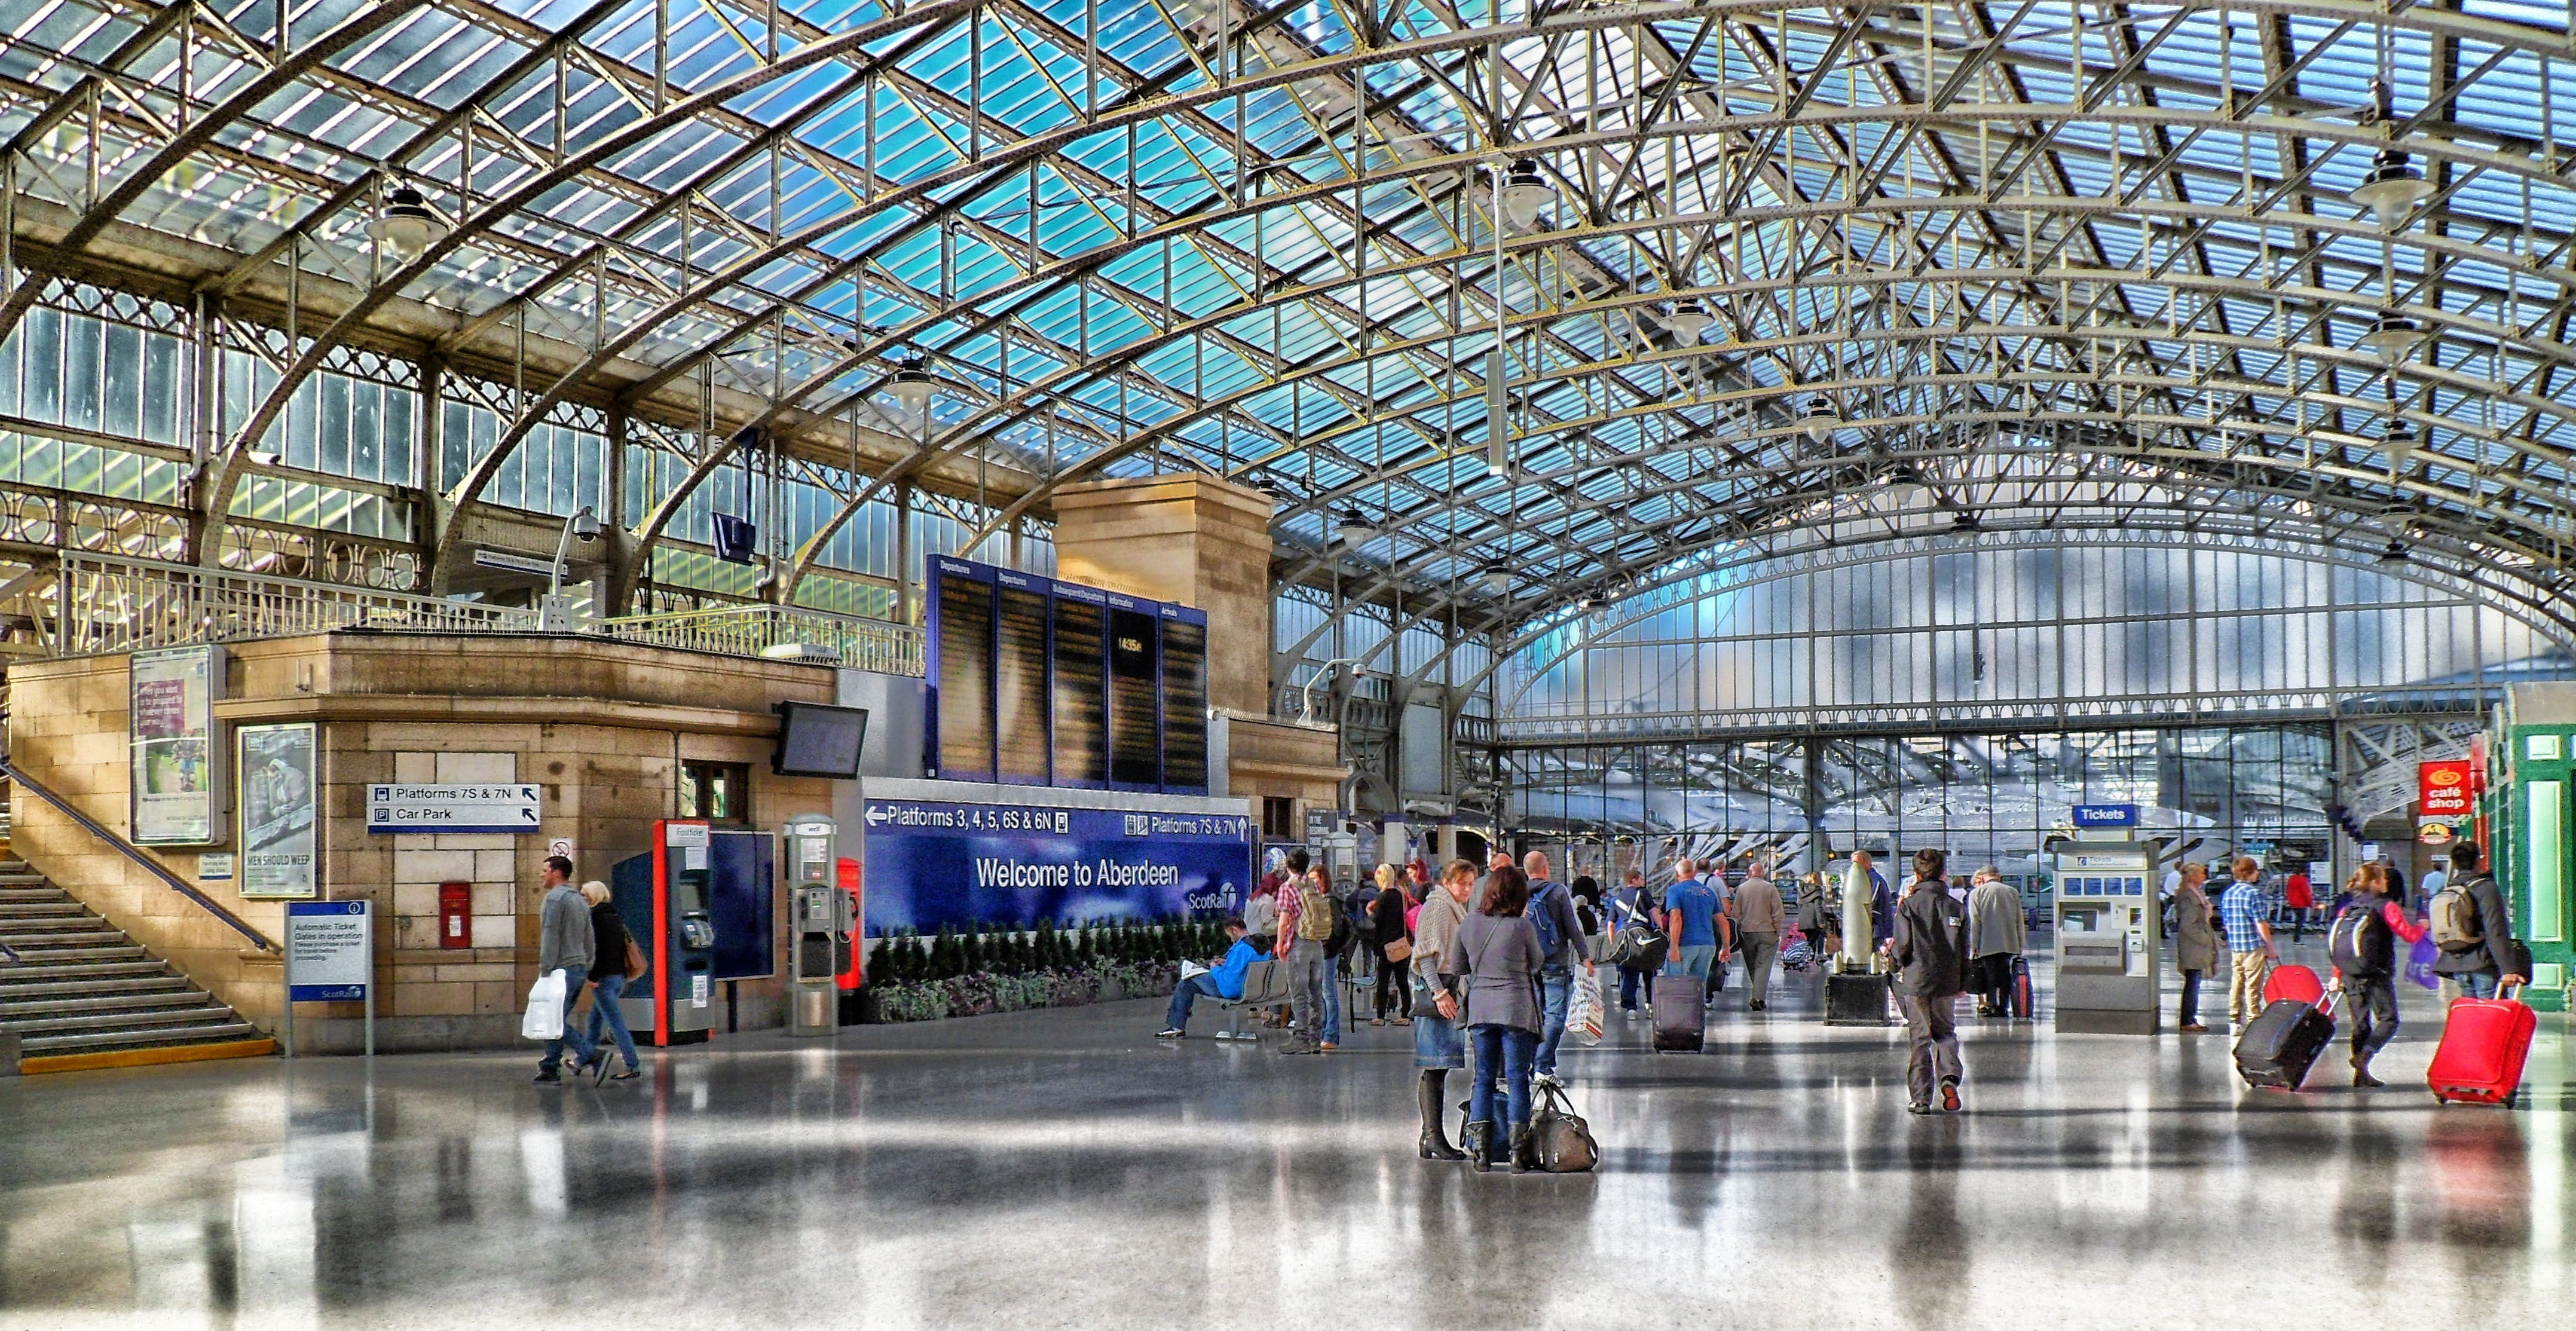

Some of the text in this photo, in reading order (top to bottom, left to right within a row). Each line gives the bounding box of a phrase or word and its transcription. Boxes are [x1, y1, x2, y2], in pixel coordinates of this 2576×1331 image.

[940, 560, 971, 575] Departures
[999, 572, 1027, 586] Departures
[1053, 583, 1106, 602] Subsequent Departures
[1109, 596, 1134, 609] Information
[396, 788, 511, 798] Platforms 7S & 7N
[2429, 787, 2462, 798] café
[2427, 798, 2465, 810] shop
[396, 809, 452, 819] Car Park
[887, 805, 1052, 831] Platforms 3, 4, 5, 6S & 6N
[2081, 809, 2126, 820] Tickets
[1151, 816, 1237, 835] Platforms 7S & 7N
[247, 855, 310, 865] MEN SHOULD WEEP
[976, 858, 1179, 888] Welcome to Aberdeen
[1189, 893, 1228, 910] ScotRail
[328, 932, 362, 941] operation
